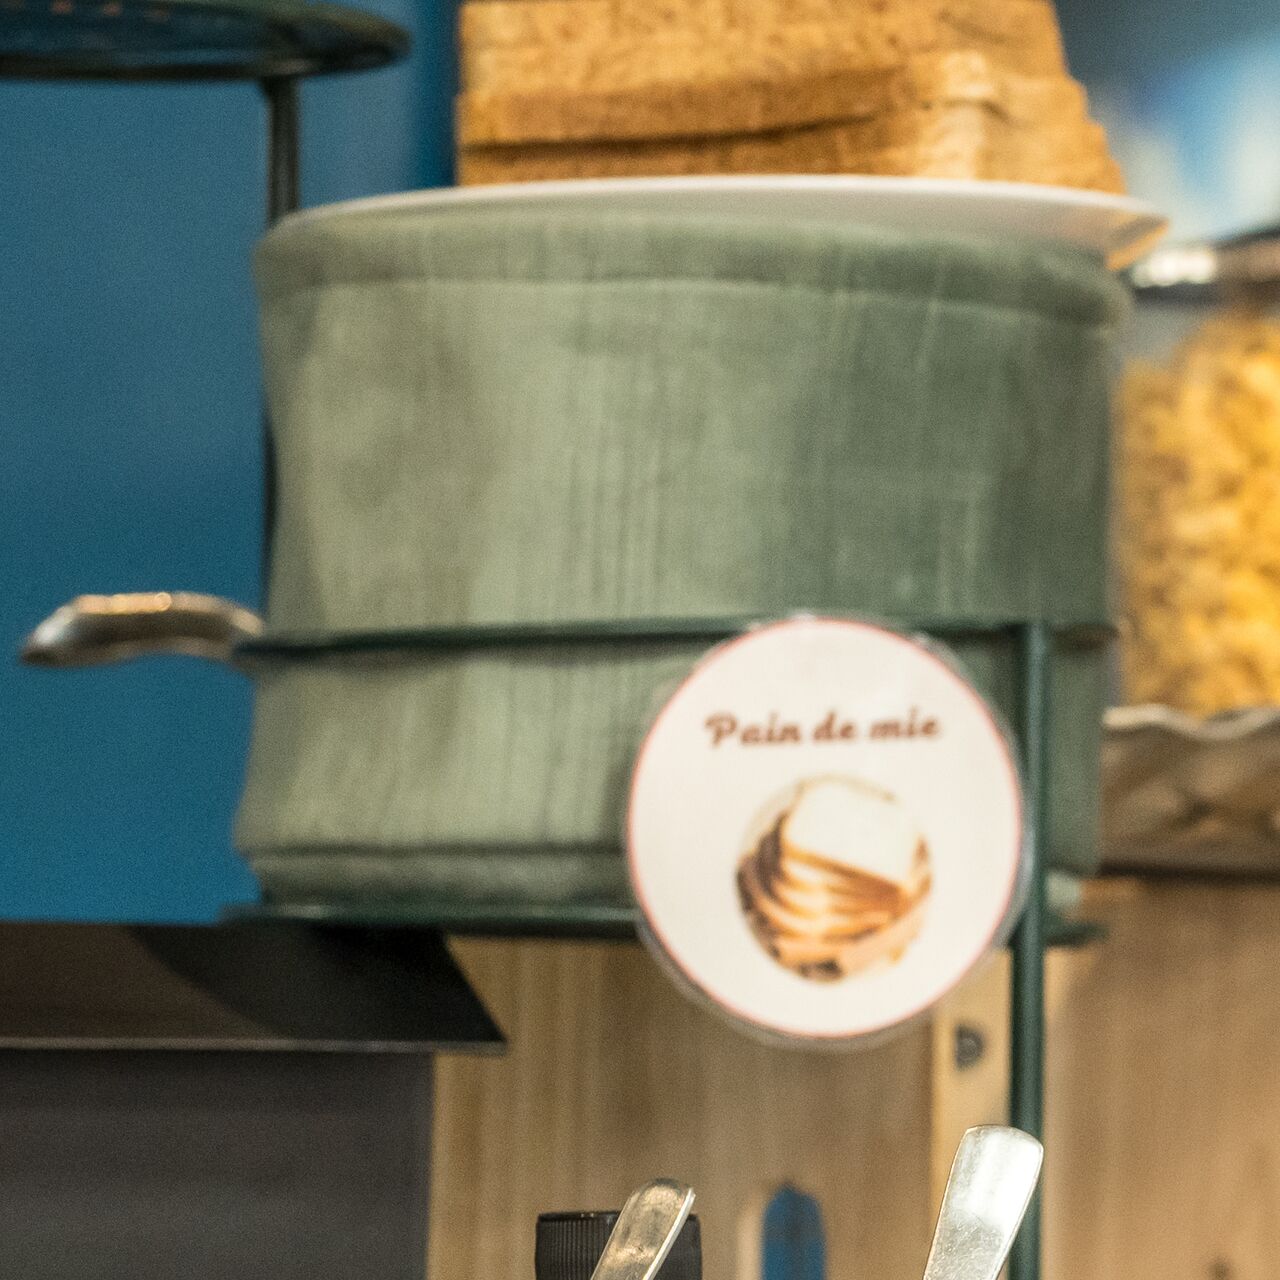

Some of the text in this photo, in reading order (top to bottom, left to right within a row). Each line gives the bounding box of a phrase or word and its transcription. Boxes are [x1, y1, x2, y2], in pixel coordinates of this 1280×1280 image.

[703, 704, 939, 749] Pain de mie
